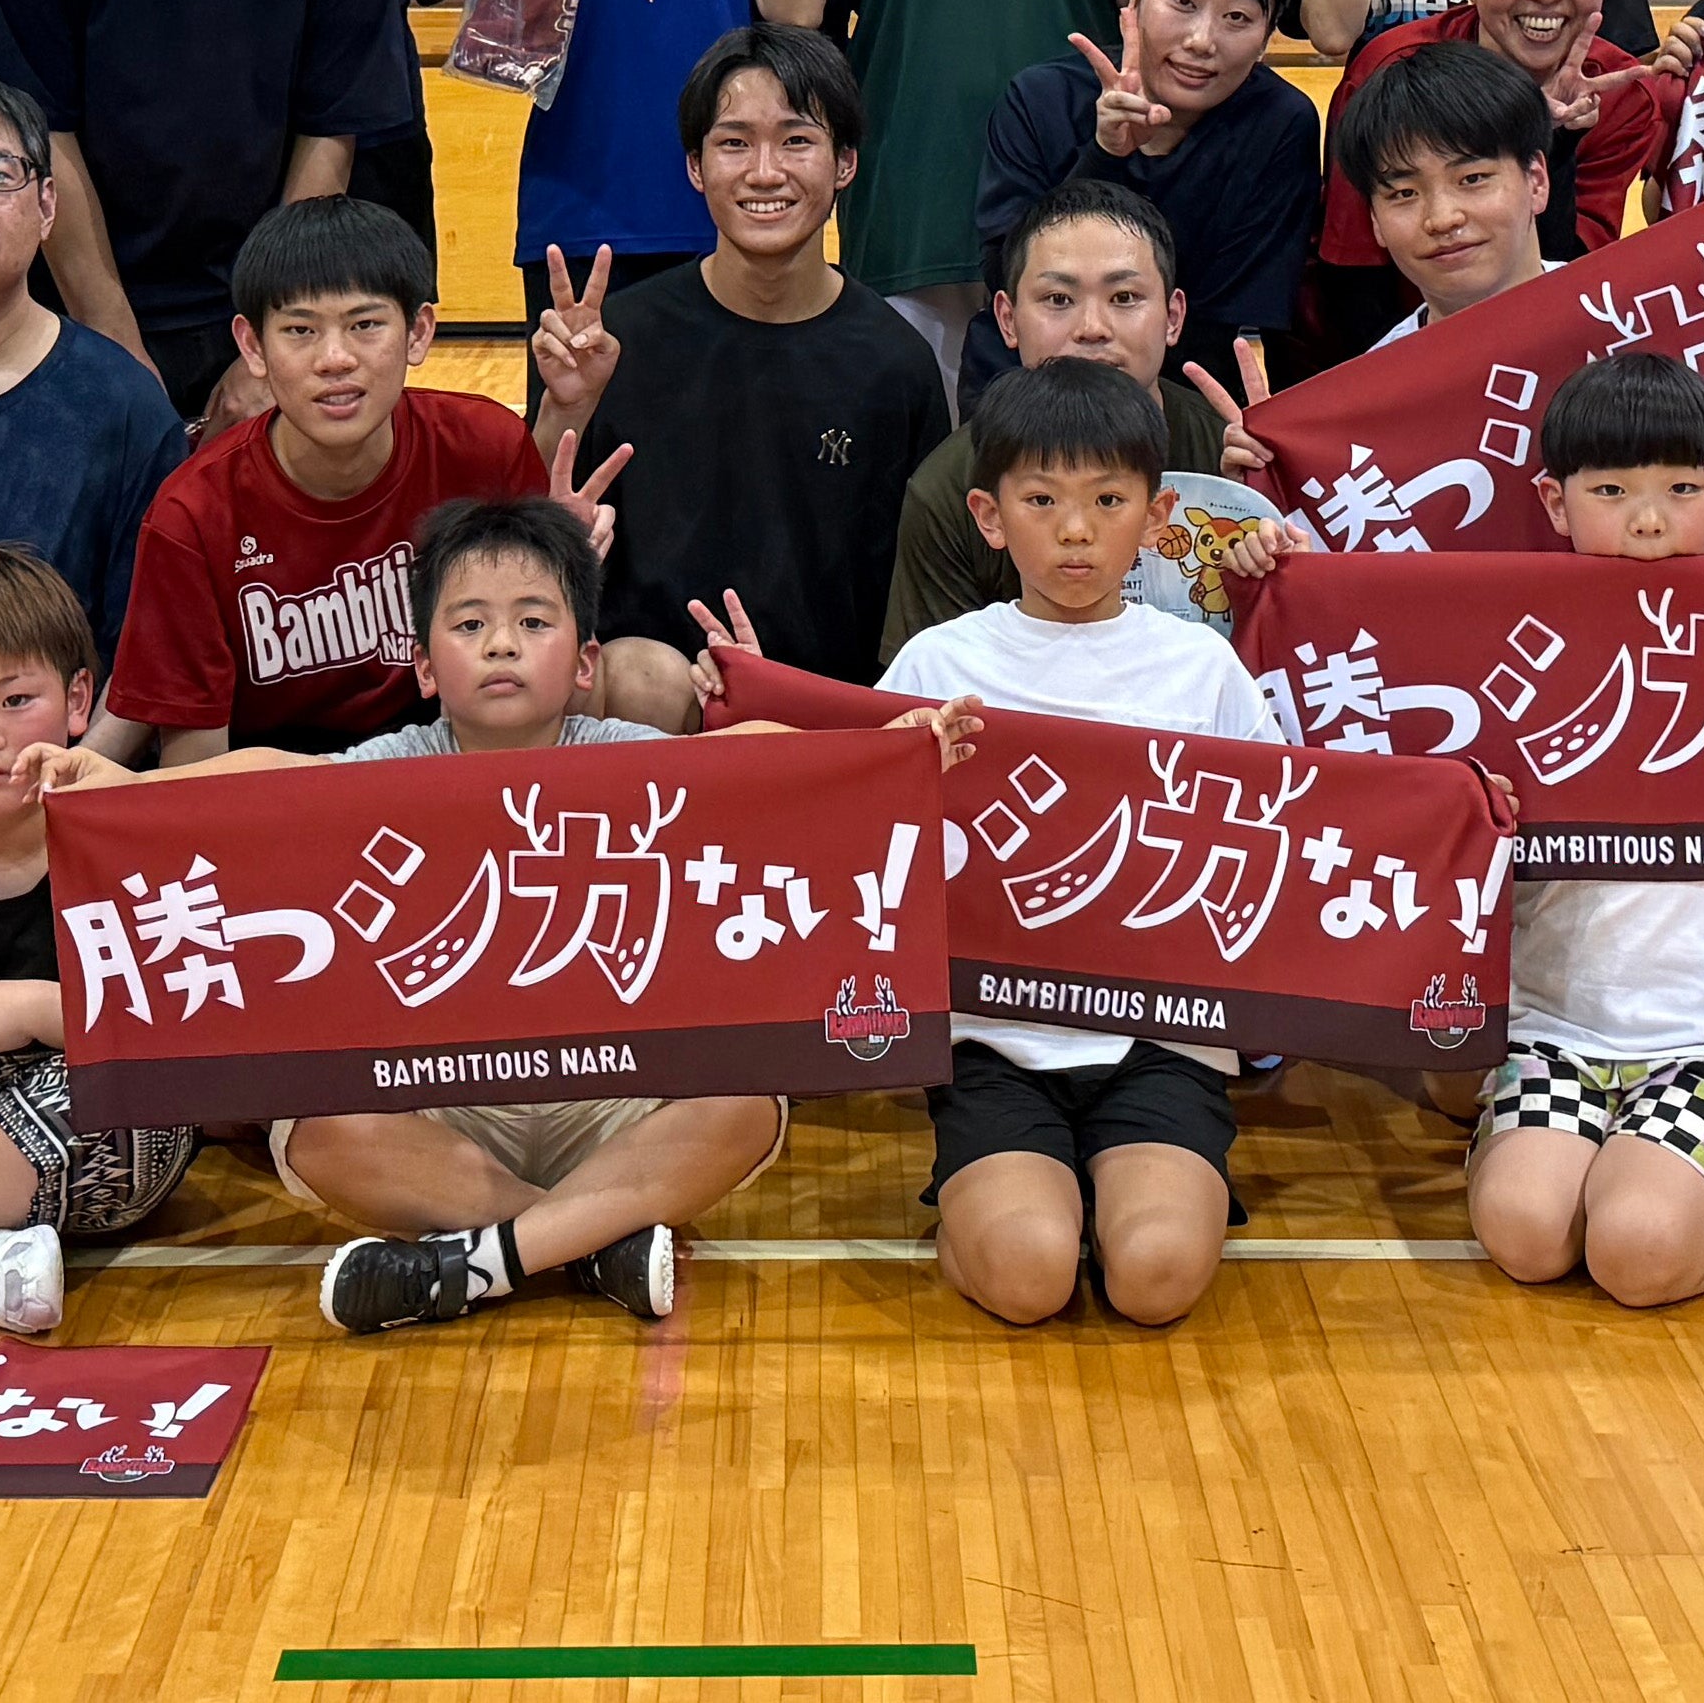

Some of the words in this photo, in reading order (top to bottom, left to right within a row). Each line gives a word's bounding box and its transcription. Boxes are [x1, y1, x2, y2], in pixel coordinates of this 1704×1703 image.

[1513, 834, 1675, 865] BAMBITIOUS
[979, 973, 1145, 1020] BAMBITIOUS
[1154, 994, 1228, 1030] NARA
[373, 1049, 551, 1089] BAMBITIOUS
[559, 1042, 638, 1077] NARA
